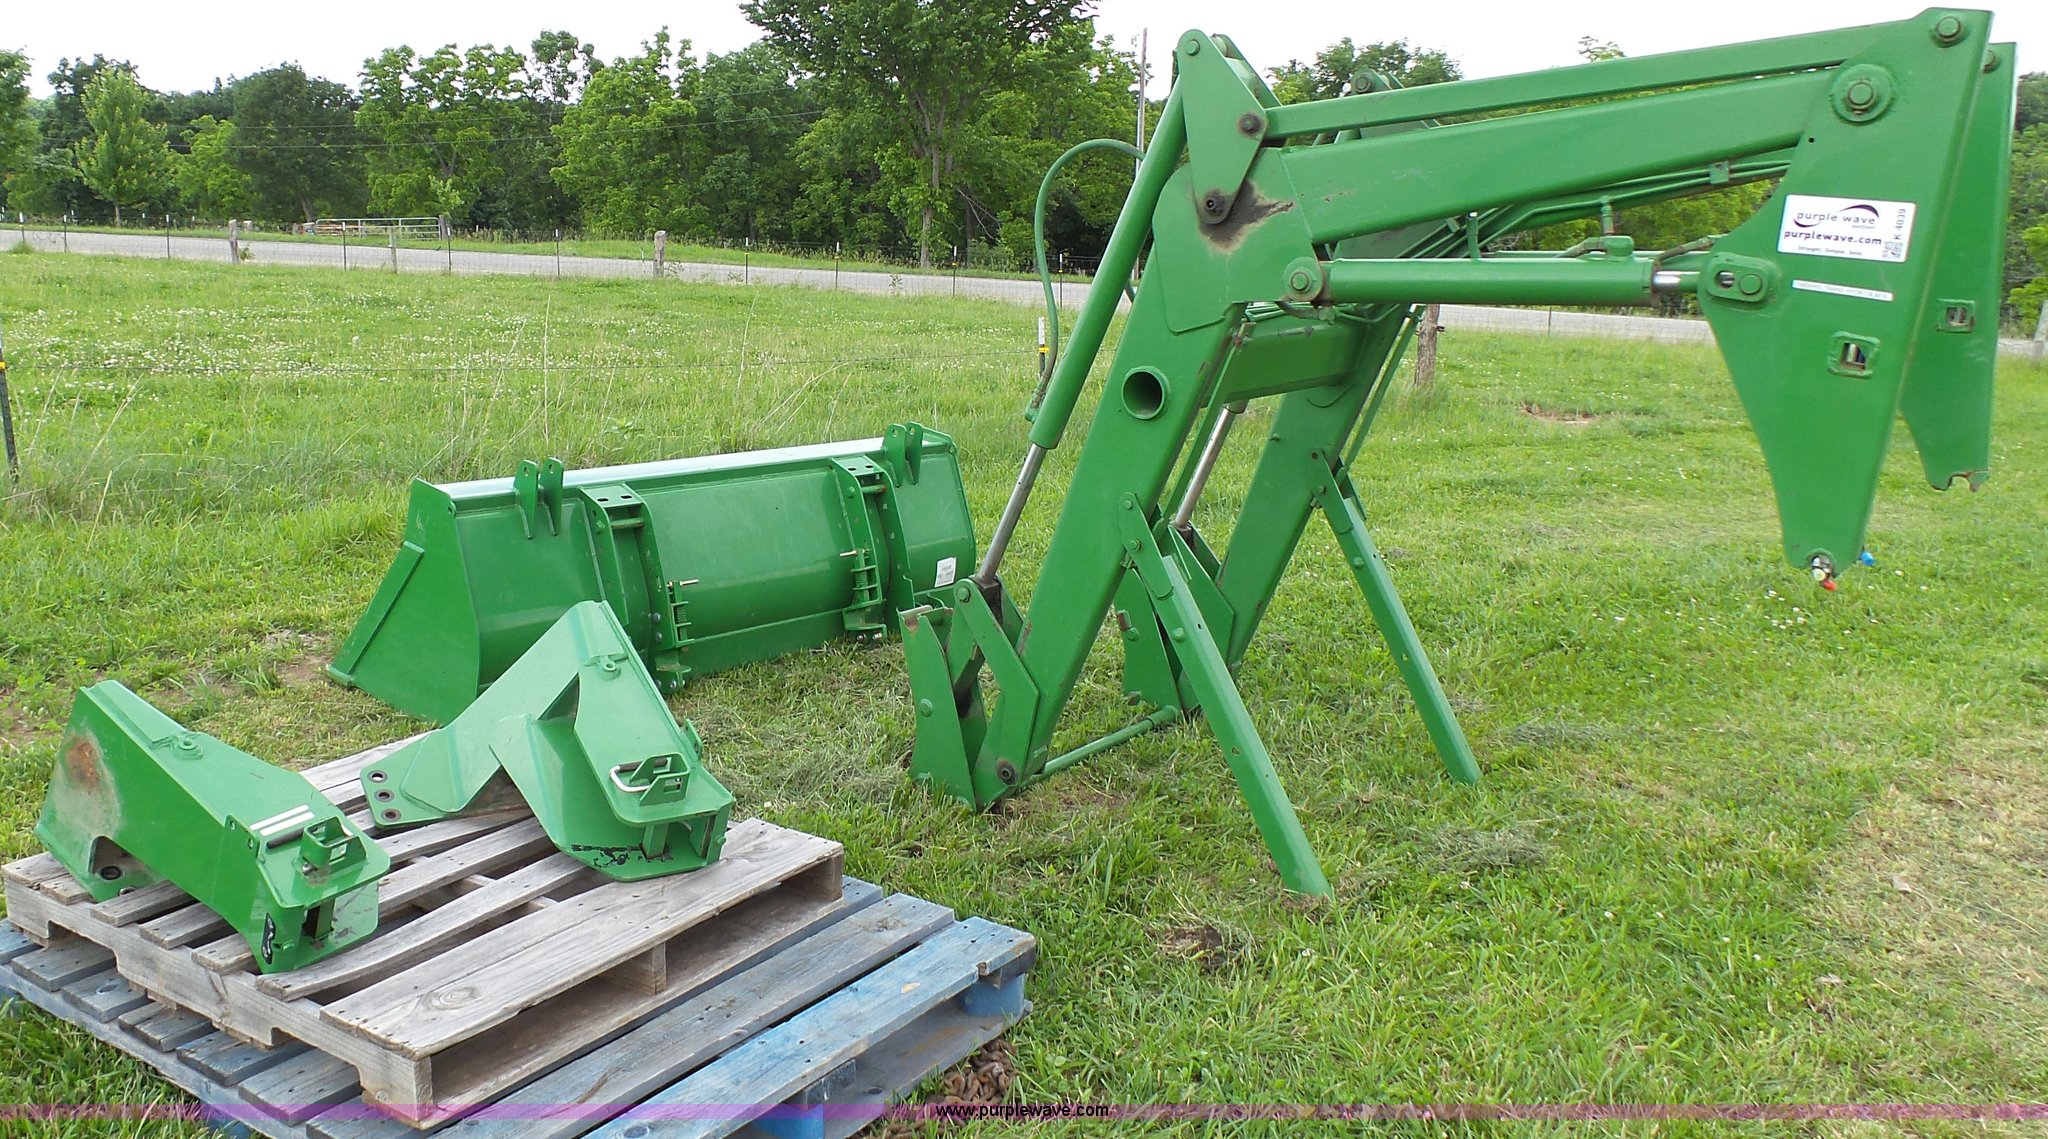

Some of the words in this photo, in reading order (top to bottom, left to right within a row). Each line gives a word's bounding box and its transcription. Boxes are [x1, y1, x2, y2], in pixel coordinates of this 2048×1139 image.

[1797, 211, 1838, 224] purple
[1842, 215, 1876, 225] wave
[1784, 230, 1882, 246] purplewave.com
